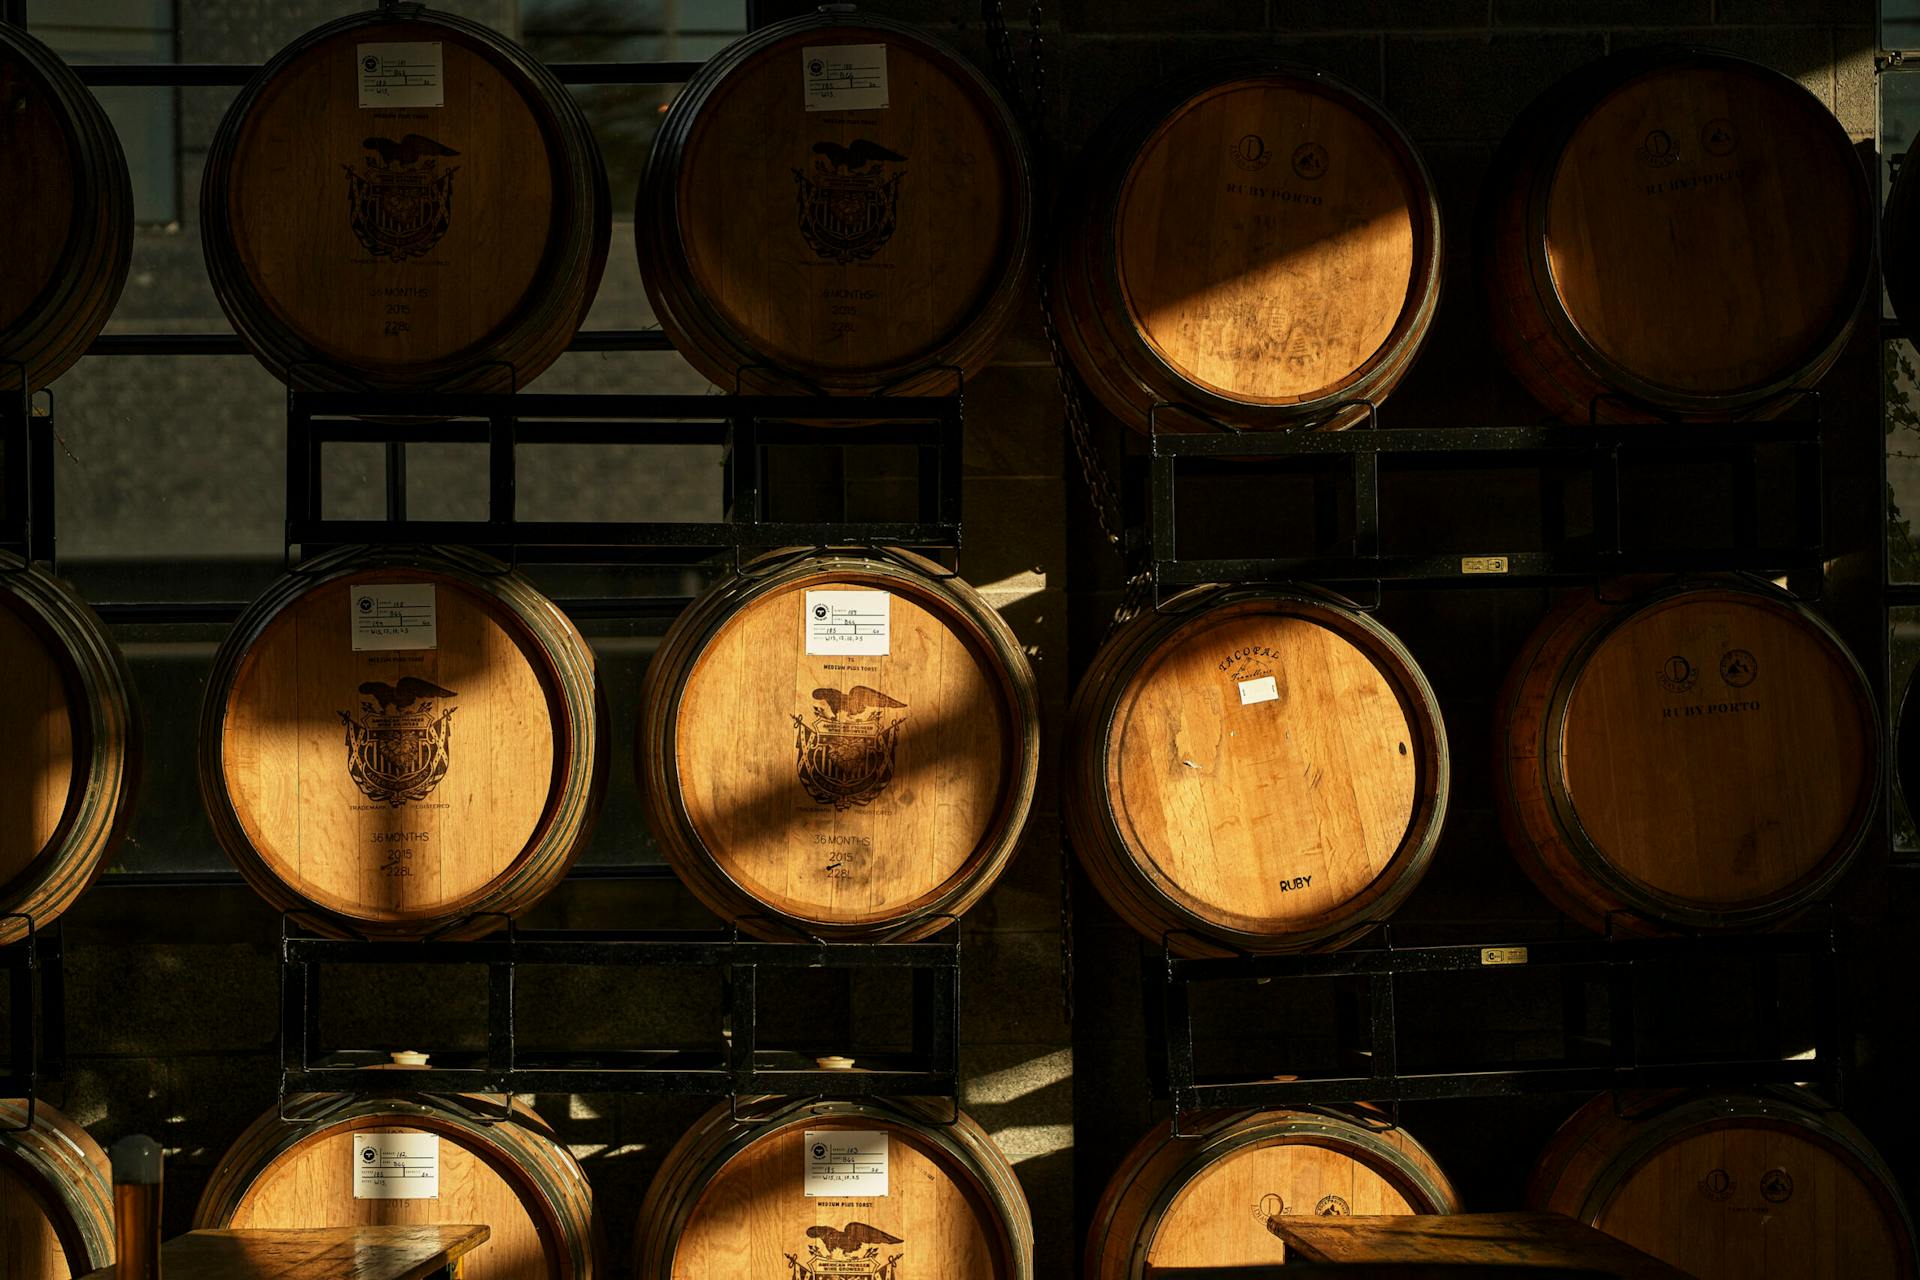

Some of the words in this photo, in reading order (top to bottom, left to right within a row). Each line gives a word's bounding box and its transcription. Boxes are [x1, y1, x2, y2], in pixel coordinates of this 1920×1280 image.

[1226, 183, 1268, 198] RUBY
[1271, 188, 1322, 206] PORTO
[385, 287, 430, 298] MONTHS
[1663, 704, 1704, 718] RUBY
[1707, 700, 1760, 714] PORTO
[385, 831, 430, 843] MONTHS
[814, 834, 827, 845] 36
[828, 835, 871, 847] MONTHS
[387, 848, 413, 860] 2015
[829, 851, 854, 863] 2015
[386, 866, 414, 877] 228L
[827, 868, 853, 880] 228L
[1279, 875, 1312, 892] RUBY
[384, 1199, 410, 1208] 2015
